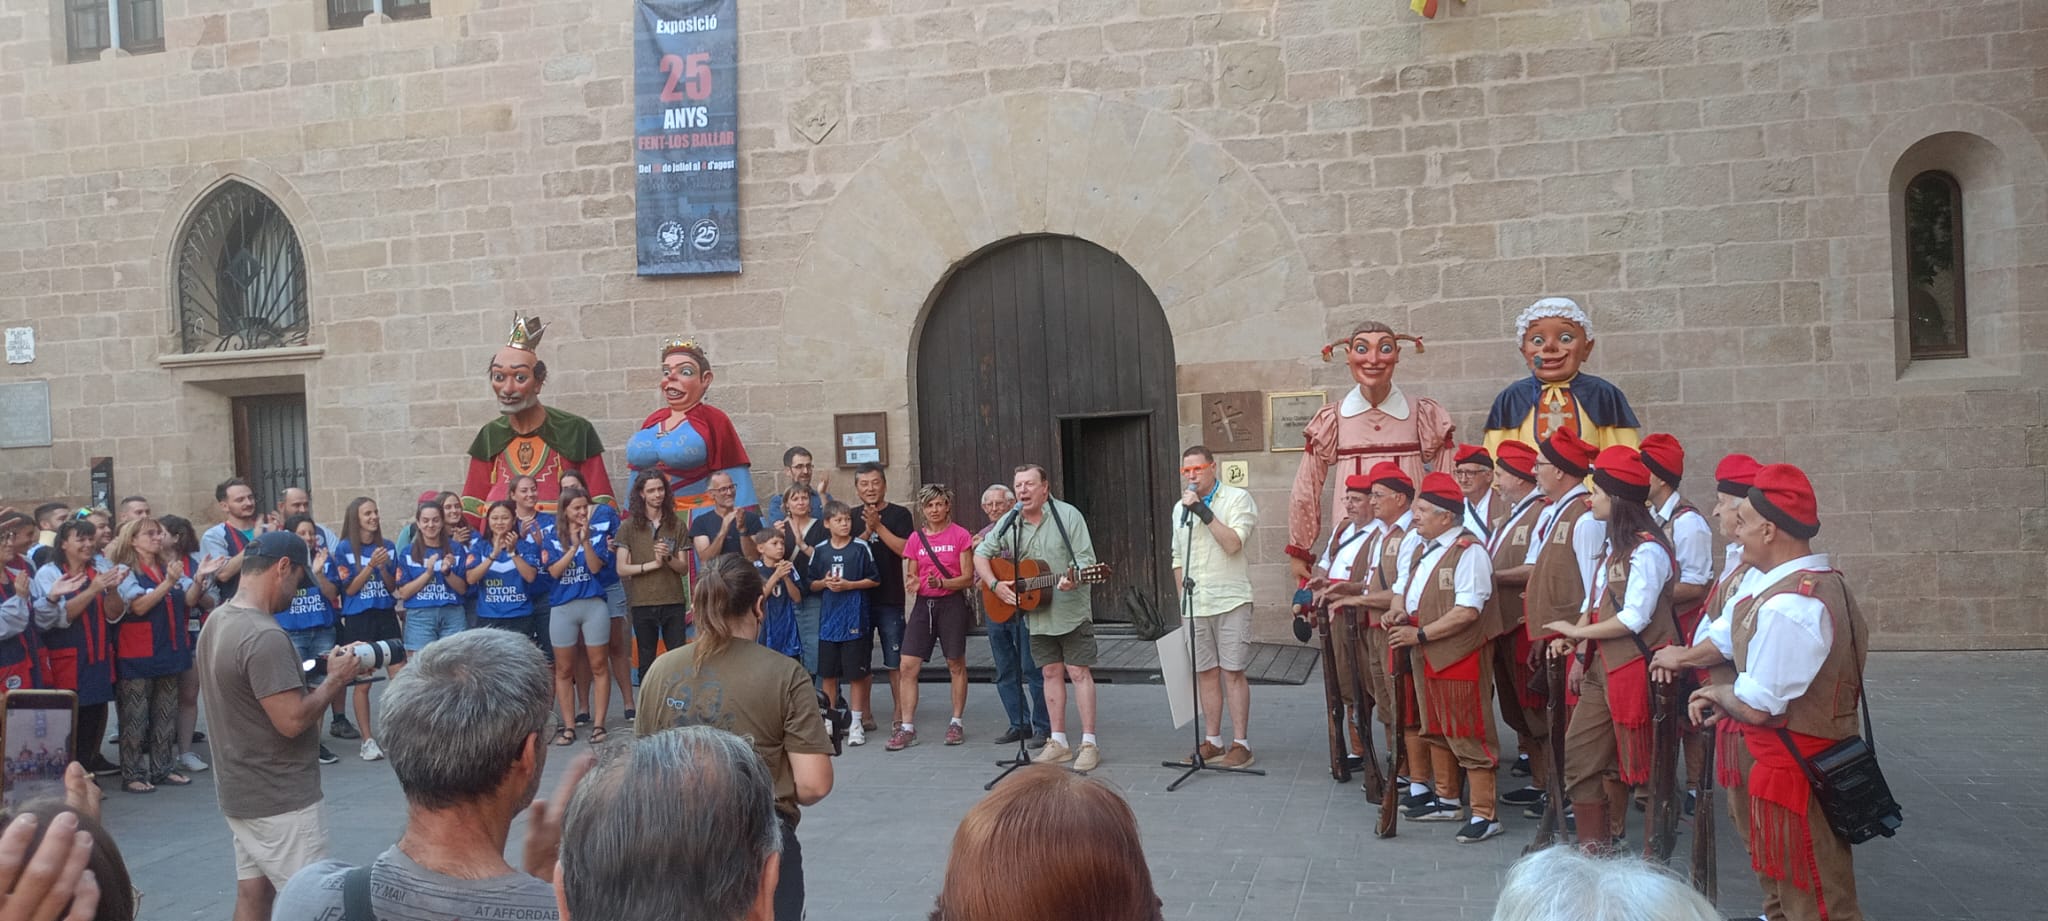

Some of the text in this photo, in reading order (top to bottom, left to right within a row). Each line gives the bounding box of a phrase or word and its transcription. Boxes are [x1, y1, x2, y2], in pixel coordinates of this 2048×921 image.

[656, 14, 717, 35] Exposició
[660, 52, 712, 102] 25
[664, 106, 708, 129] ANYS
[638, 131, 734, 150] FENT-LOS BALLAR
[639, 164, 651, 173] Del
[663, 163, 672, 173] de
[672, 161, 692, 173] juliol
[693, 161, 700, 170] al
[708, 160, 734, 171] d'agost
[695, 226, 717, 244] 25
[486, 586, 516, 595] OTOR
[475, 907, 560, 921] AT AFFORDAB
